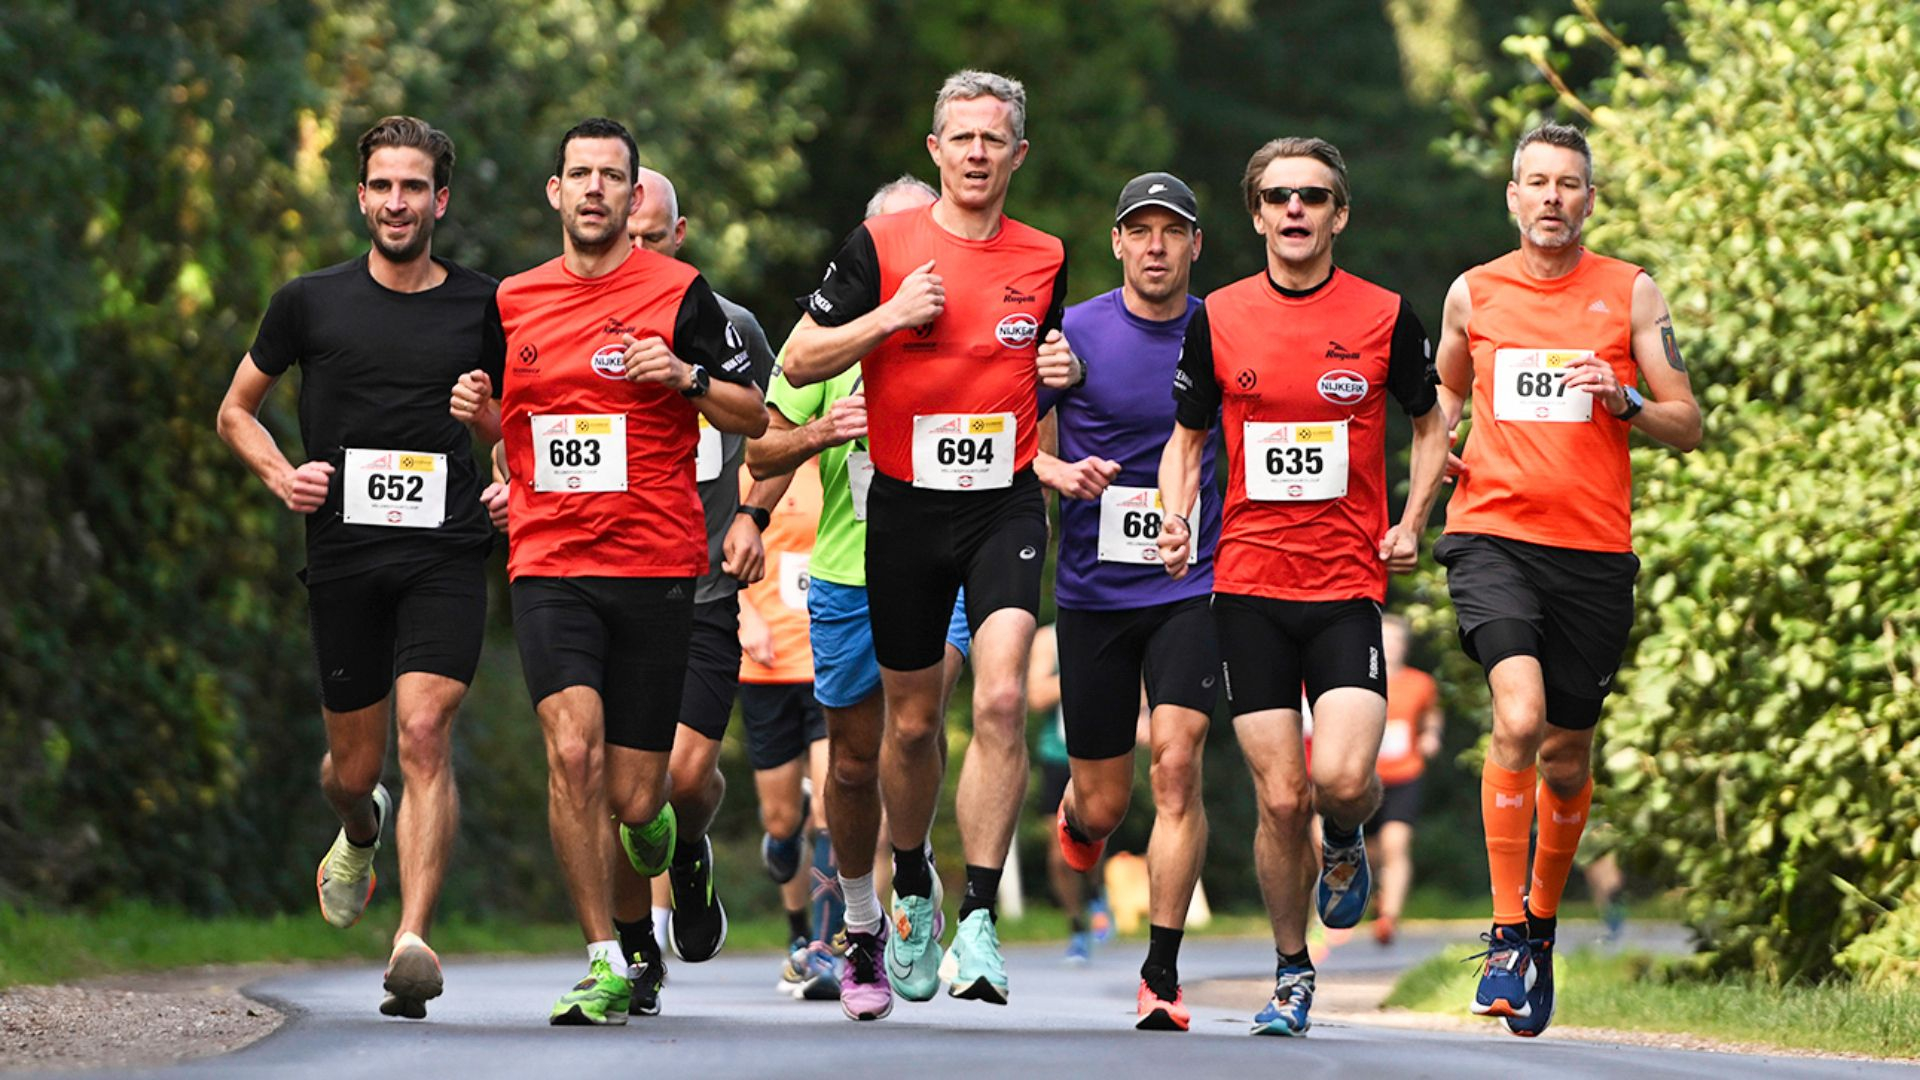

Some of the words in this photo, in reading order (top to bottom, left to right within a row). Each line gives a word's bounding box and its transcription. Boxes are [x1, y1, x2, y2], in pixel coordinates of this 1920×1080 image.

[594, 357, 625, 367] NIJKE
[1320, 381, 1365, 393] NIJKERK
[1516, 371, 1567, 398] 687
[549, 438, 602, 468] 683
[937, 437, 995, 466] 694
[1265, 446, 1324, 476] 635
[367, 473, 424, 503] 652
[1122, 510, 1162, 540] 68
